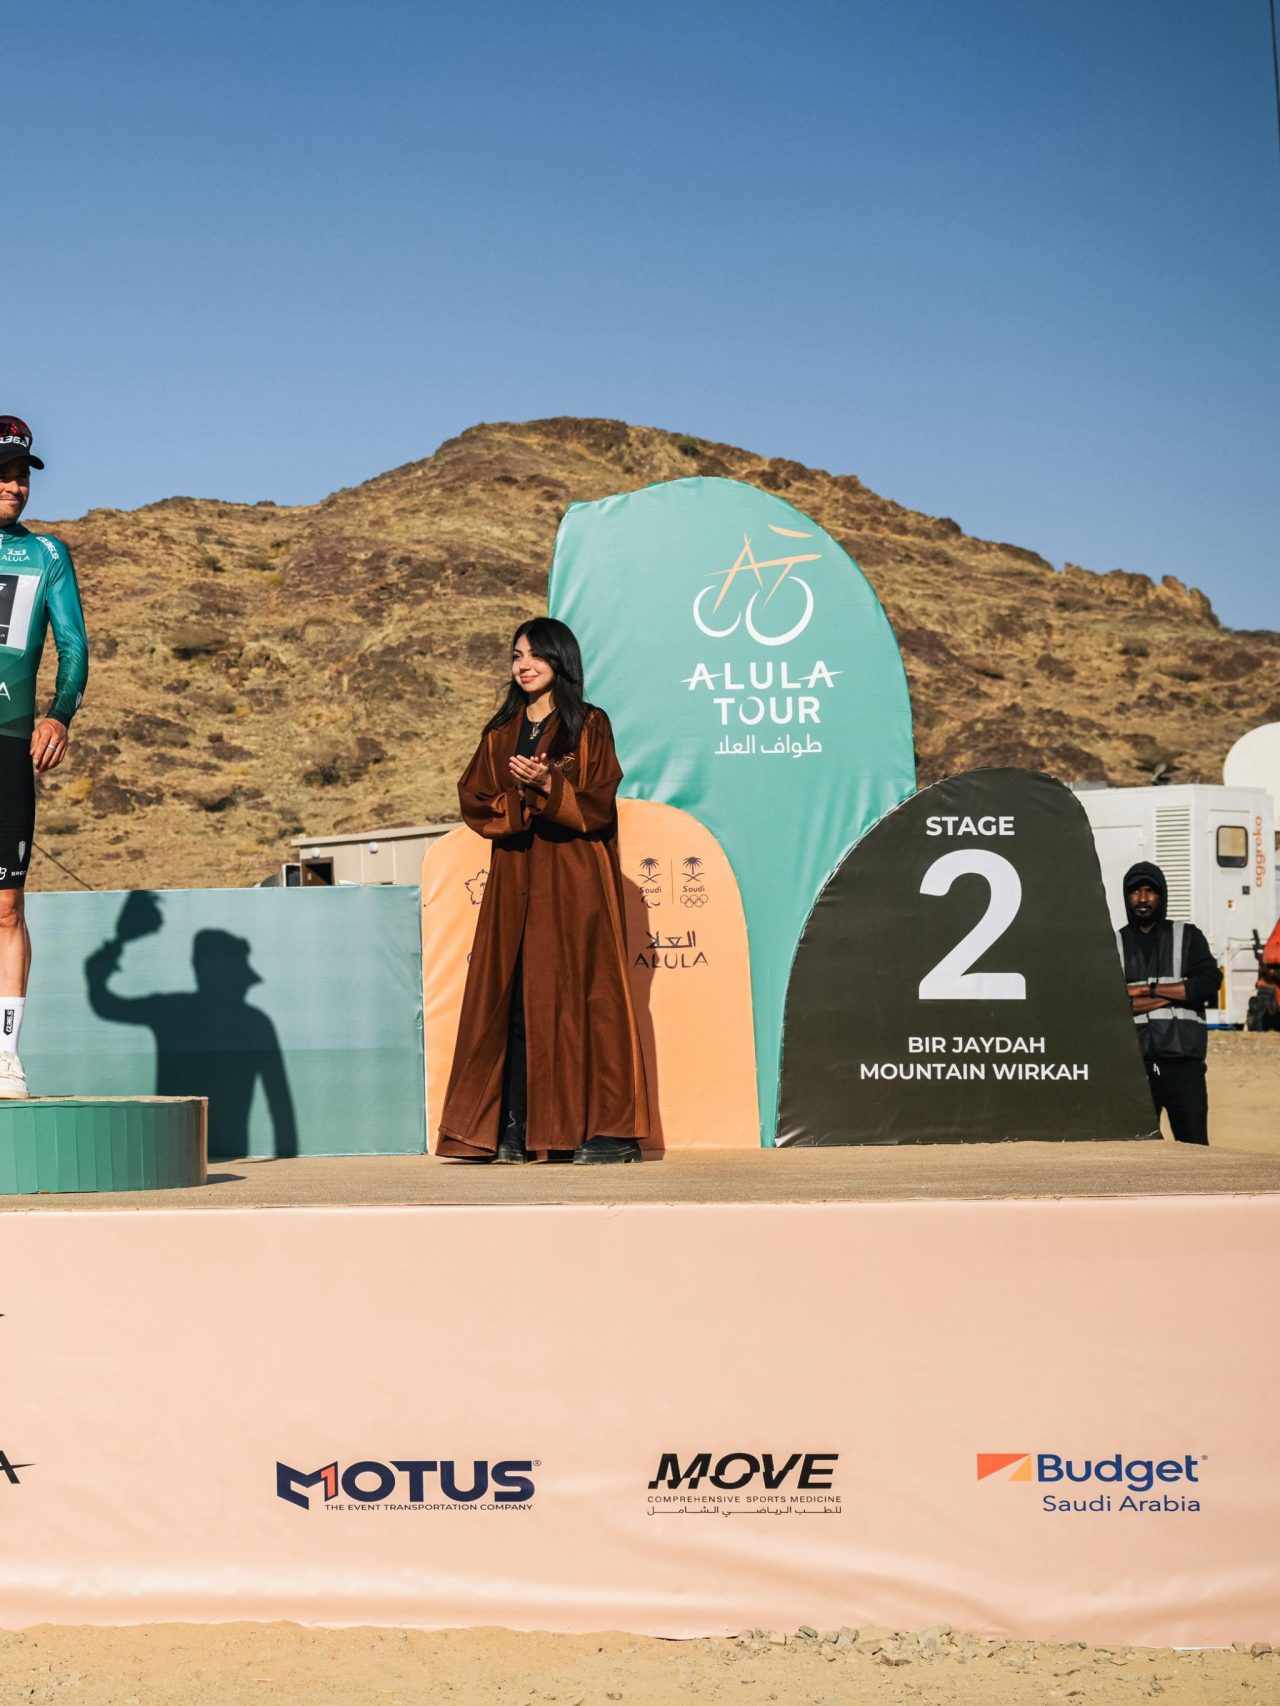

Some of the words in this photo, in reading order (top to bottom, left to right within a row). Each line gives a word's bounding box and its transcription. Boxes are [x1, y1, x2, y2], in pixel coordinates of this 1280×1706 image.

[1, 554, 31, 562] ALULA
[679, 660, 844, 691] ALULA
[713, 696, 821, 726] TOUR
[760, 733, 823, 759] طواف
[925, 815, 1016, 837] STAGE
[639, 886, 662, 894] Saudi
[682, 885, 705, 893] Saudi
[918, 848, 1027, 1000] 2
[634, 951, 709, 969] ALULA
[908, 1037, 946, 1054] BIR
[952, 1036, 1046, 1054] JAYDAH
[860, 1063, 986, 1081] MOUNTAIN
[992, 1063, 1089, 1081] WIRKAH
[647, 1452, 840, 1490] MOVE
[1037, 1453, 1199, 1492] Budget
[276, 1460, 536, 1511] MOTUS
[325, 1503, 345, 1511] THE
[348, 1503, 381, 1511] EVENT
[384, 1503, 477, 1511] TRANSPORTATION
[480, 1503, 533, 1511] COMPANY
[1042, 1494, 1111, 1512] Saudi
[1118, 1494, 1201, 1512] Arabia
